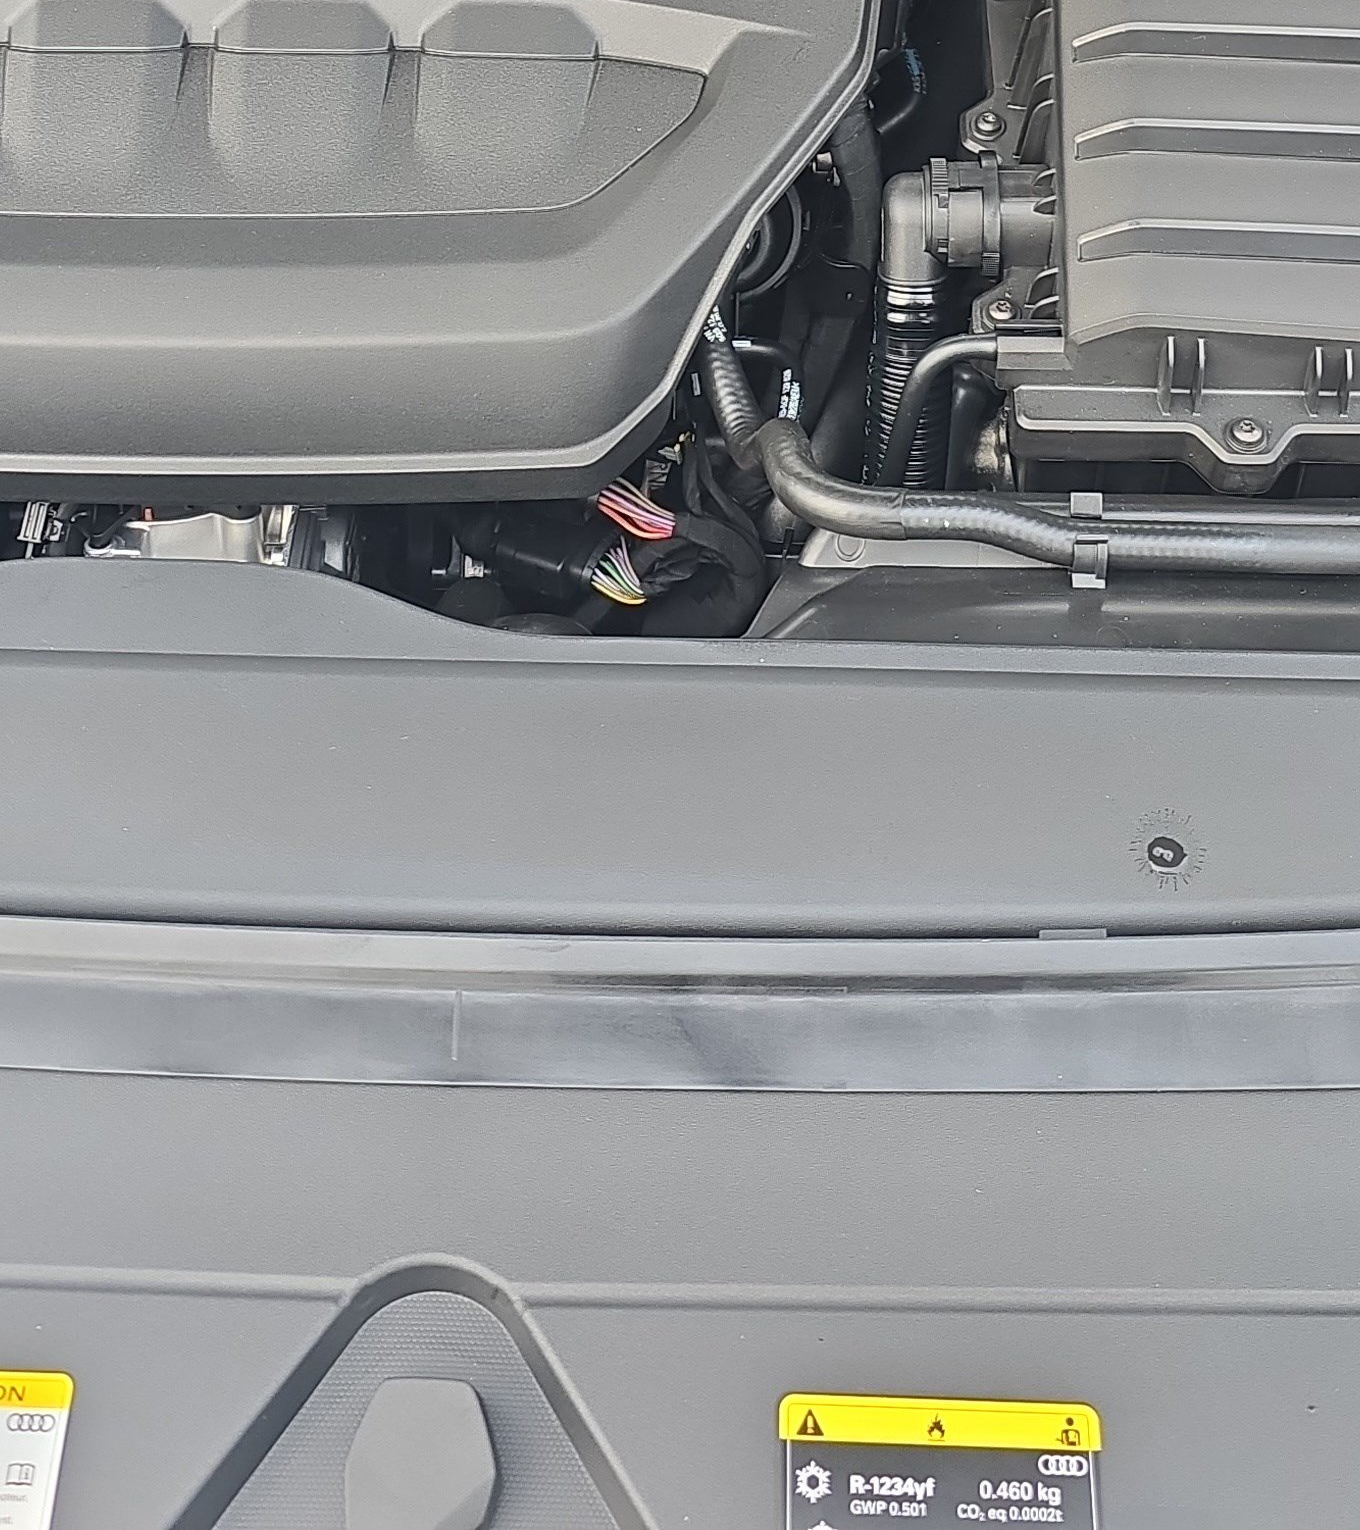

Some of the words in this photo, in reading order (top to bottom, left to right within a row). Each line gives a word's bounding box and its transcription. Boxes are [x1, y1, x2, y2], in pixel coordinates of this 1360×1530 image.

[849, 1474, 937, 1501] R-1234yf
[979, 1481, 1034, 1501] 0.460
[1037, 1483, 1062, 1505] kg
[850, 1500, 888, 1516] GWP
[889, 1501, 928, 1518] 0.501
[987, 1507, 1007, 1523] eq
[1009, 1507, 1064, 1523] 0.0002t
